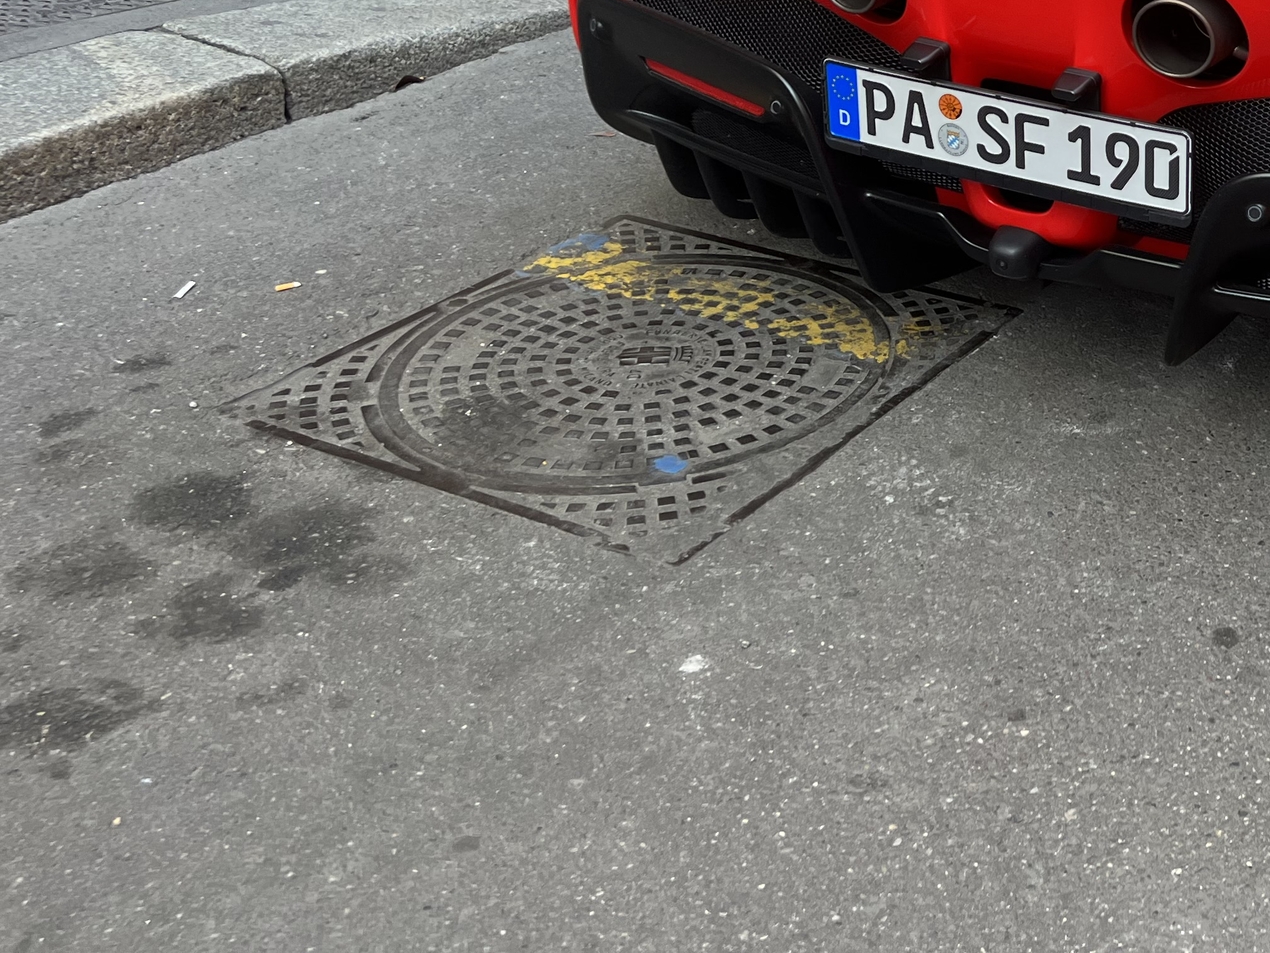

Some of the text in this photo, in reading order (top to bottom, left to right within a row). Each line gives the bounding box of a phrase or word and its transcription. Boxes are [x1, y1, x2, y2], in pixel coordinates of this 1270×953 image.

[839, 109, 850, 126] D
[862, 79, 935, 150] PA
[976, 105, 1050, 170] SF
[1066, 124, 1181, 201] 190
